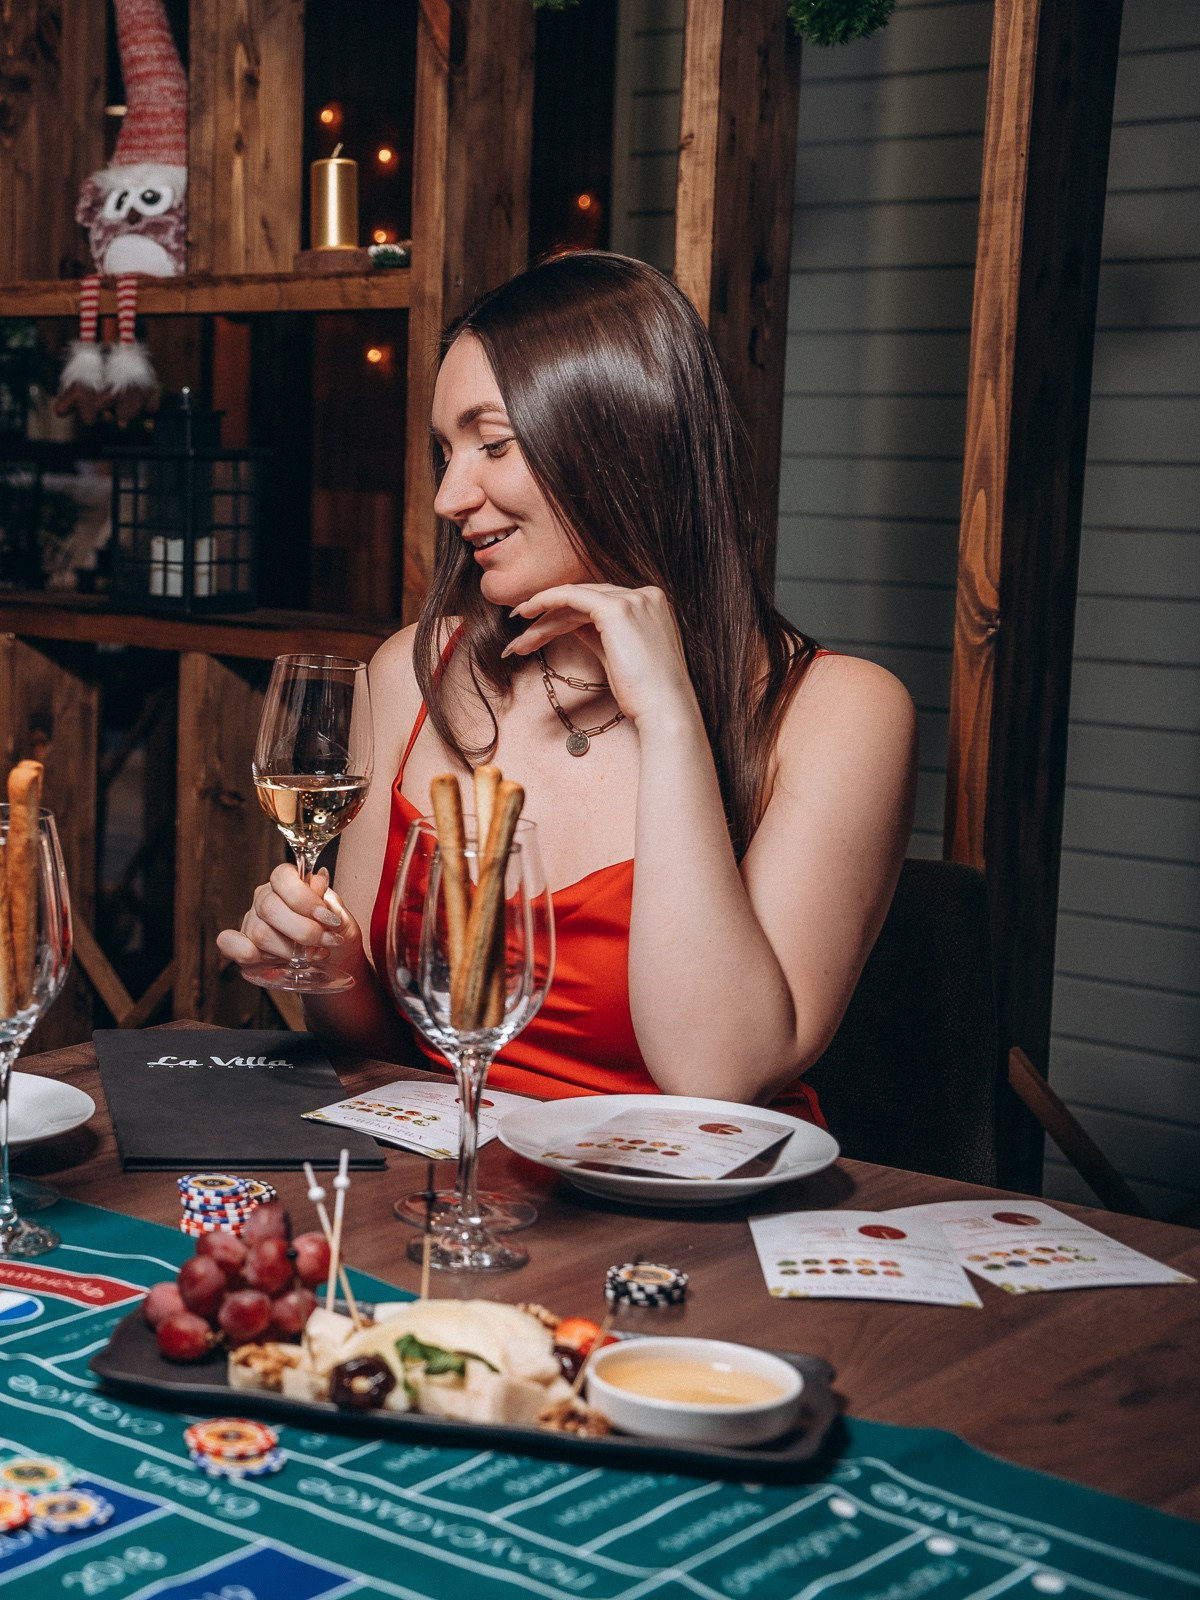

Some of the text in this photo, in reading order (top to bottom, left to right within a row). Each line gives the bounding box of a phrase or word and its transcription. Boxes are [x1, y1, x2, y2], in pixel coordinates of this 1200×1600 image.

[147, 1056, 293, 1066] La Villa
[61, 1545, 168, 1596] 2018
